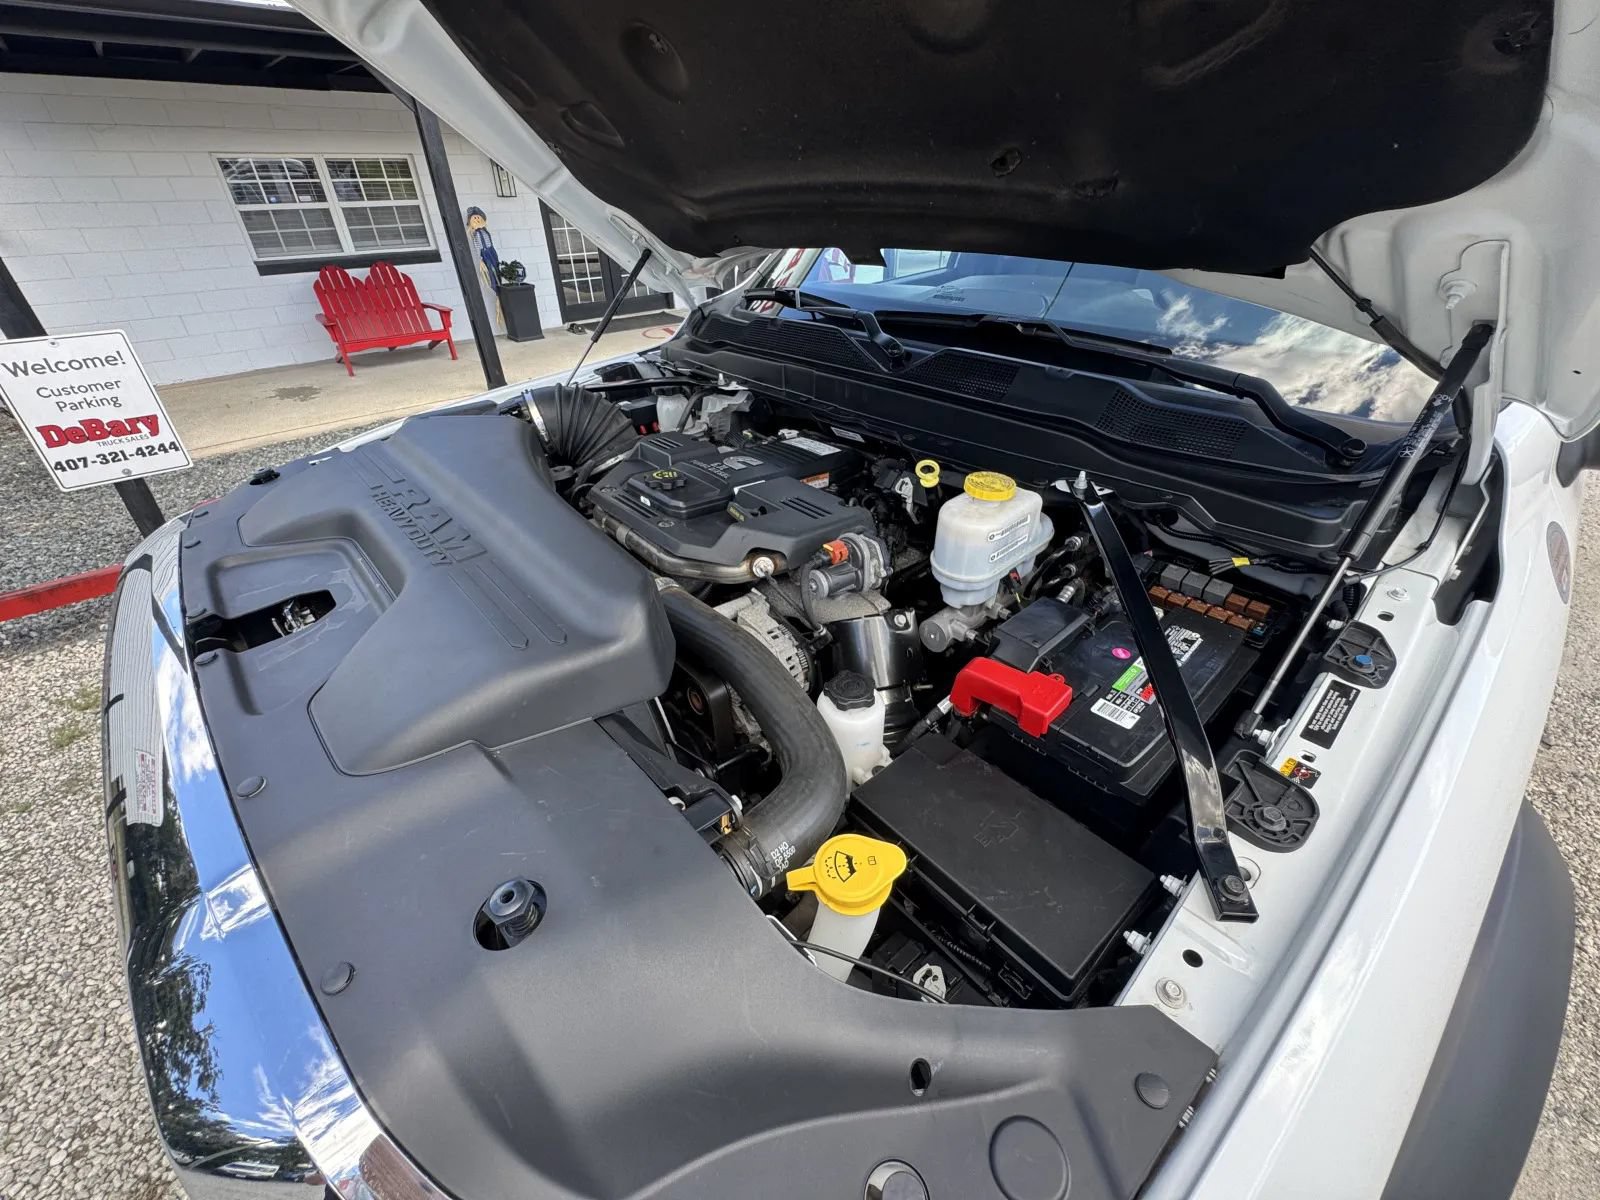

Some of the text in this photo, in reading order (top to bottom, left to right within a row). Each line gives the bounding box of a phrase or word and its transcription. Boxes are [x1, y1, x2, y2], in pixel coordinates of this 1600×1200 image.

[1, 350, 127, 378] Welcome!
[36, 380, 122, 399] Customer
[56, 395, 123, 413] Parking
[36, 414, 160, 449] DeBary
[96, 433, 150, 448] TRUCK SALES
[53, 441, 181, 473] 407-321-4244
[371, 490, 454, 566] HEAVY DUTY
[393, 483, 488, 563] RAM
